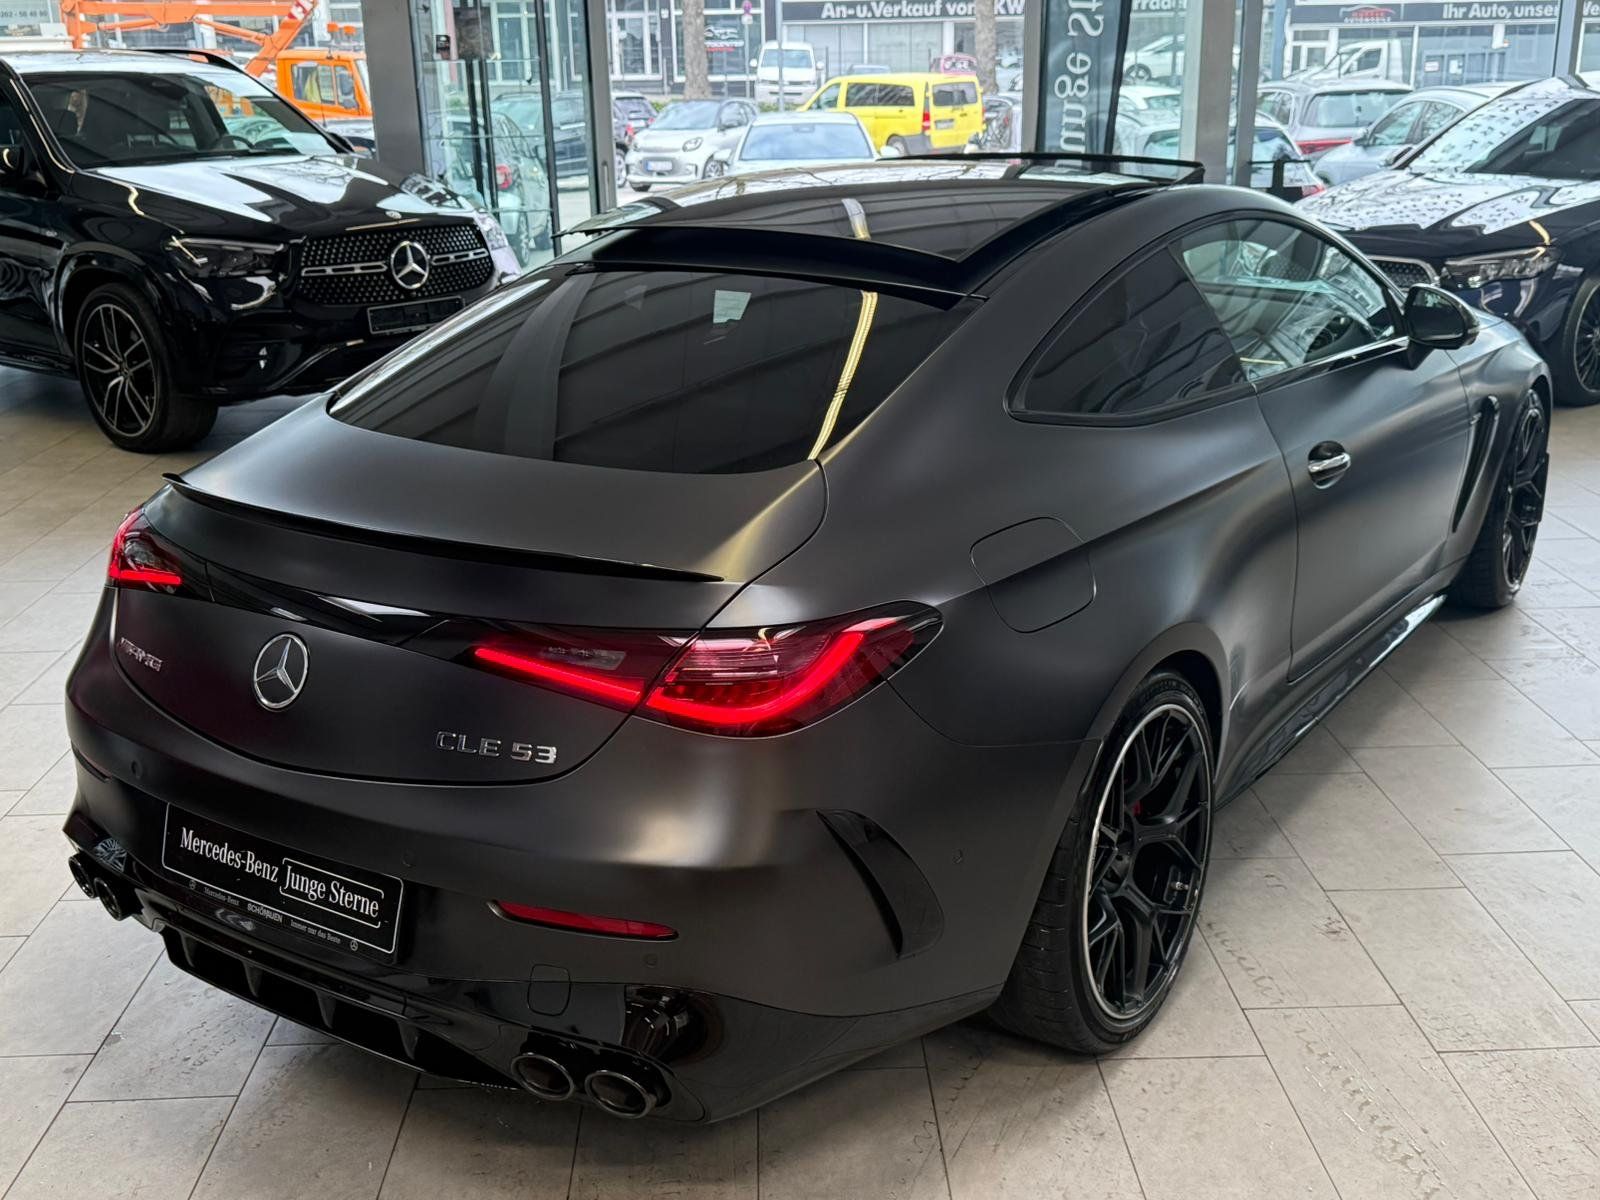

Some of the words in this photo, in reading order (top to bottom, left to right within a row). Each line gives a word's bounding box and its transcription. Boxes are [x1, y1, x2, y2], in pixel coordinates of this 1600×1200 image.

[1442, 4, 1467, 19] Ihr
[1468, 3, 1511, 19] Auto,
[435, 731, 502, 757] CLE
[510, 742, 557, 763] 53
[180, 827, 279, 882] Mercedes-Benz
[283, 865, 326, 901] Junge
[328, 880, 379, 918] Sterne
